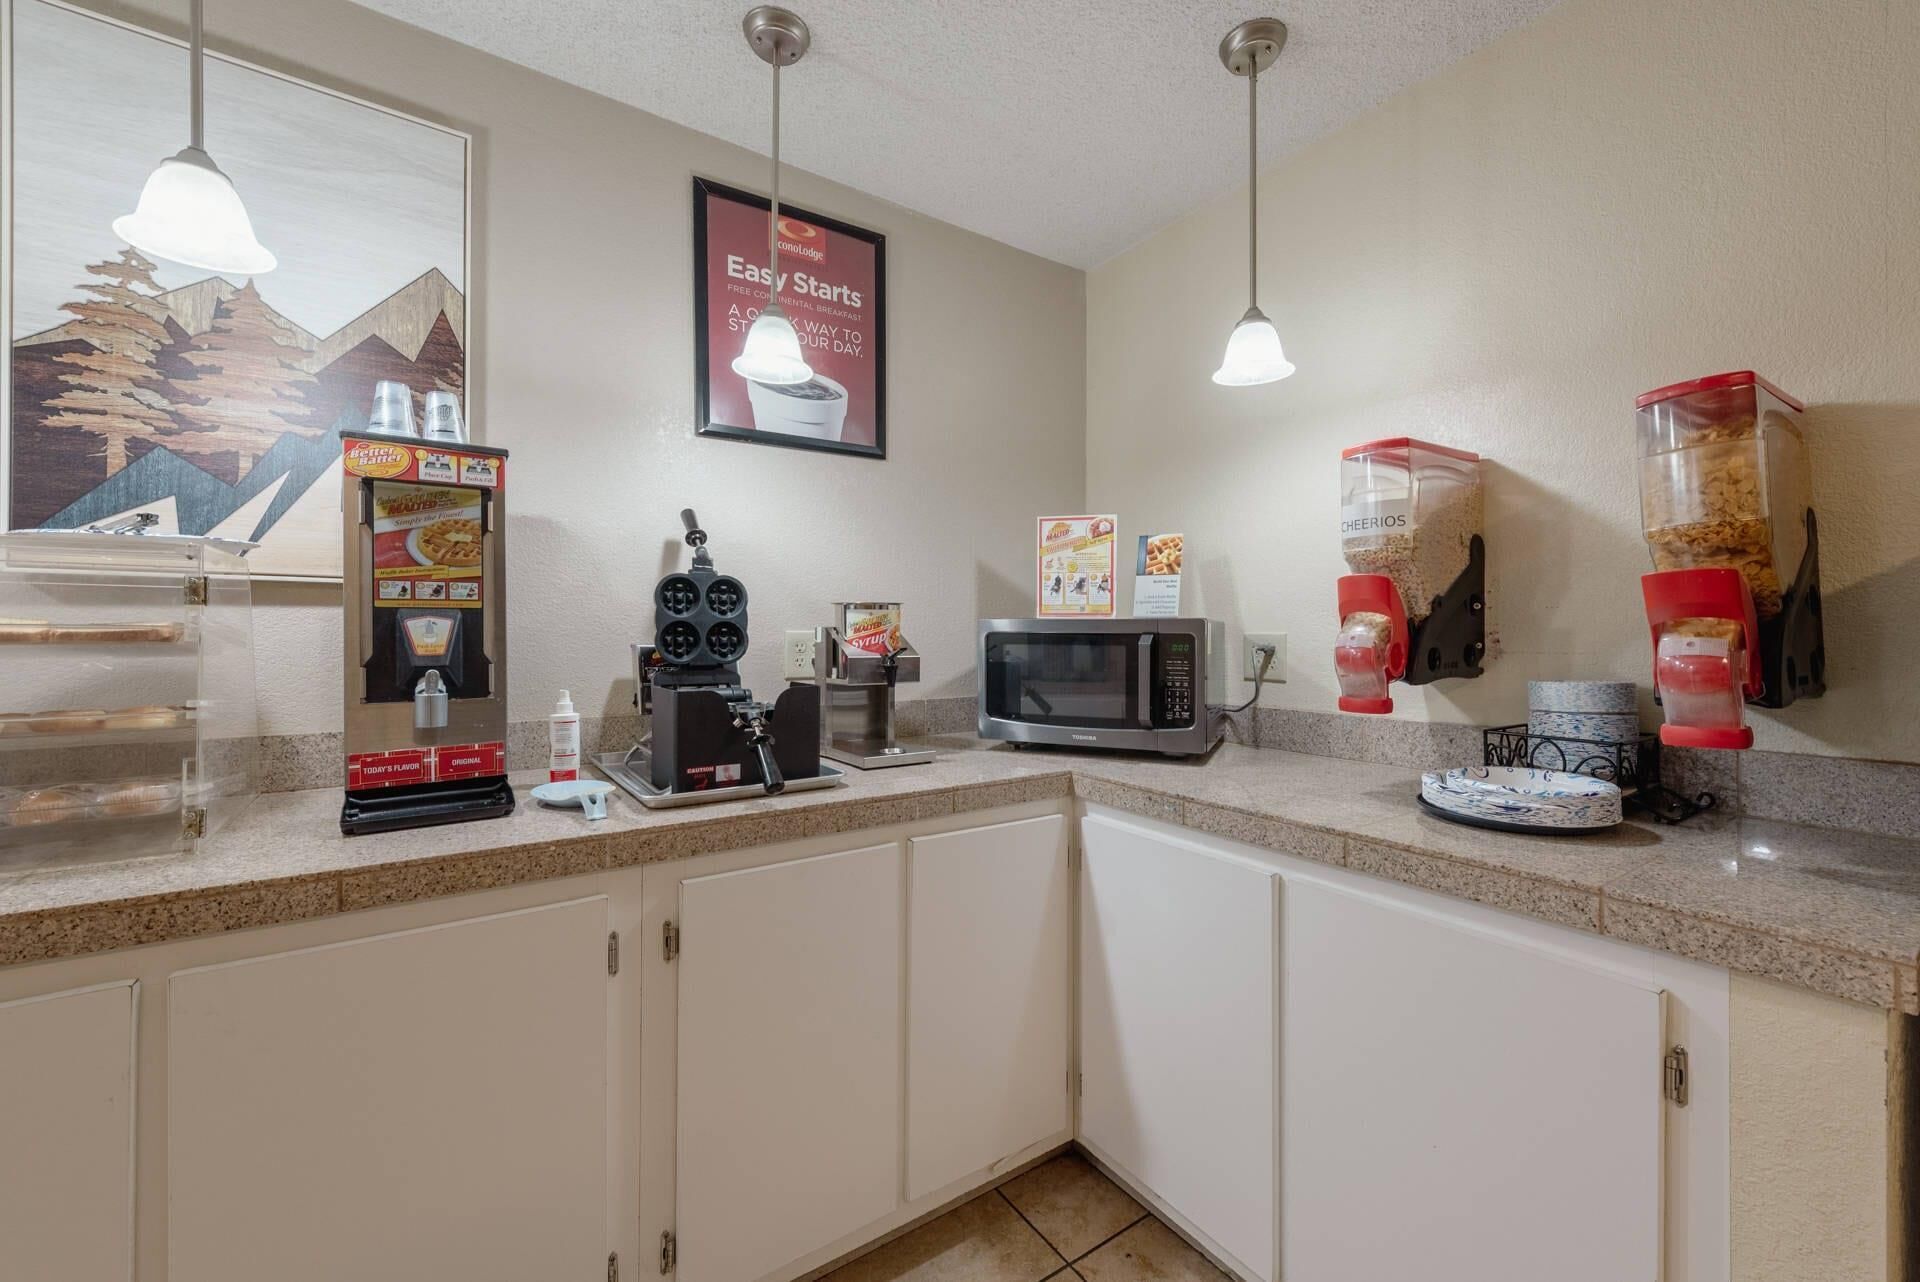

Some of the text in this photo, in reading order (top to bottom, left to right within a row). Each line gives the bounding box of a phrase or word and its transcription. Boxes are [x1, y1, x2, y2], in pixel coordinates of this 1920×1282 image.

[777, 240, 824, 261] conoLodge
[727, 254, 788, 292] Easy
[793, 271, 862, 308] Starts
[727, 283, 751, 296] FREE
[753, 289, 814, 311] CONINENTAL
[816, 304, 862, 321] BREAKFAST
[728, 303, 862, 343] A WAY TO
[797, 333, 863, 358] OUR DAY.
[351, 447, 394, 459] Better
[359, 454, 402, 466] Batter
[393, 509, 464, 527] Simply the Finest!
[1341, 514, 1407, 533] CHEERIOS
[852, 632, 888, 649] Syrup
[363, 762, 420, 775] TODAY'S FLAVOR
[451, 756, 482, 766] ORIGINAL
[687, 765, 714, 774] CAUTION
